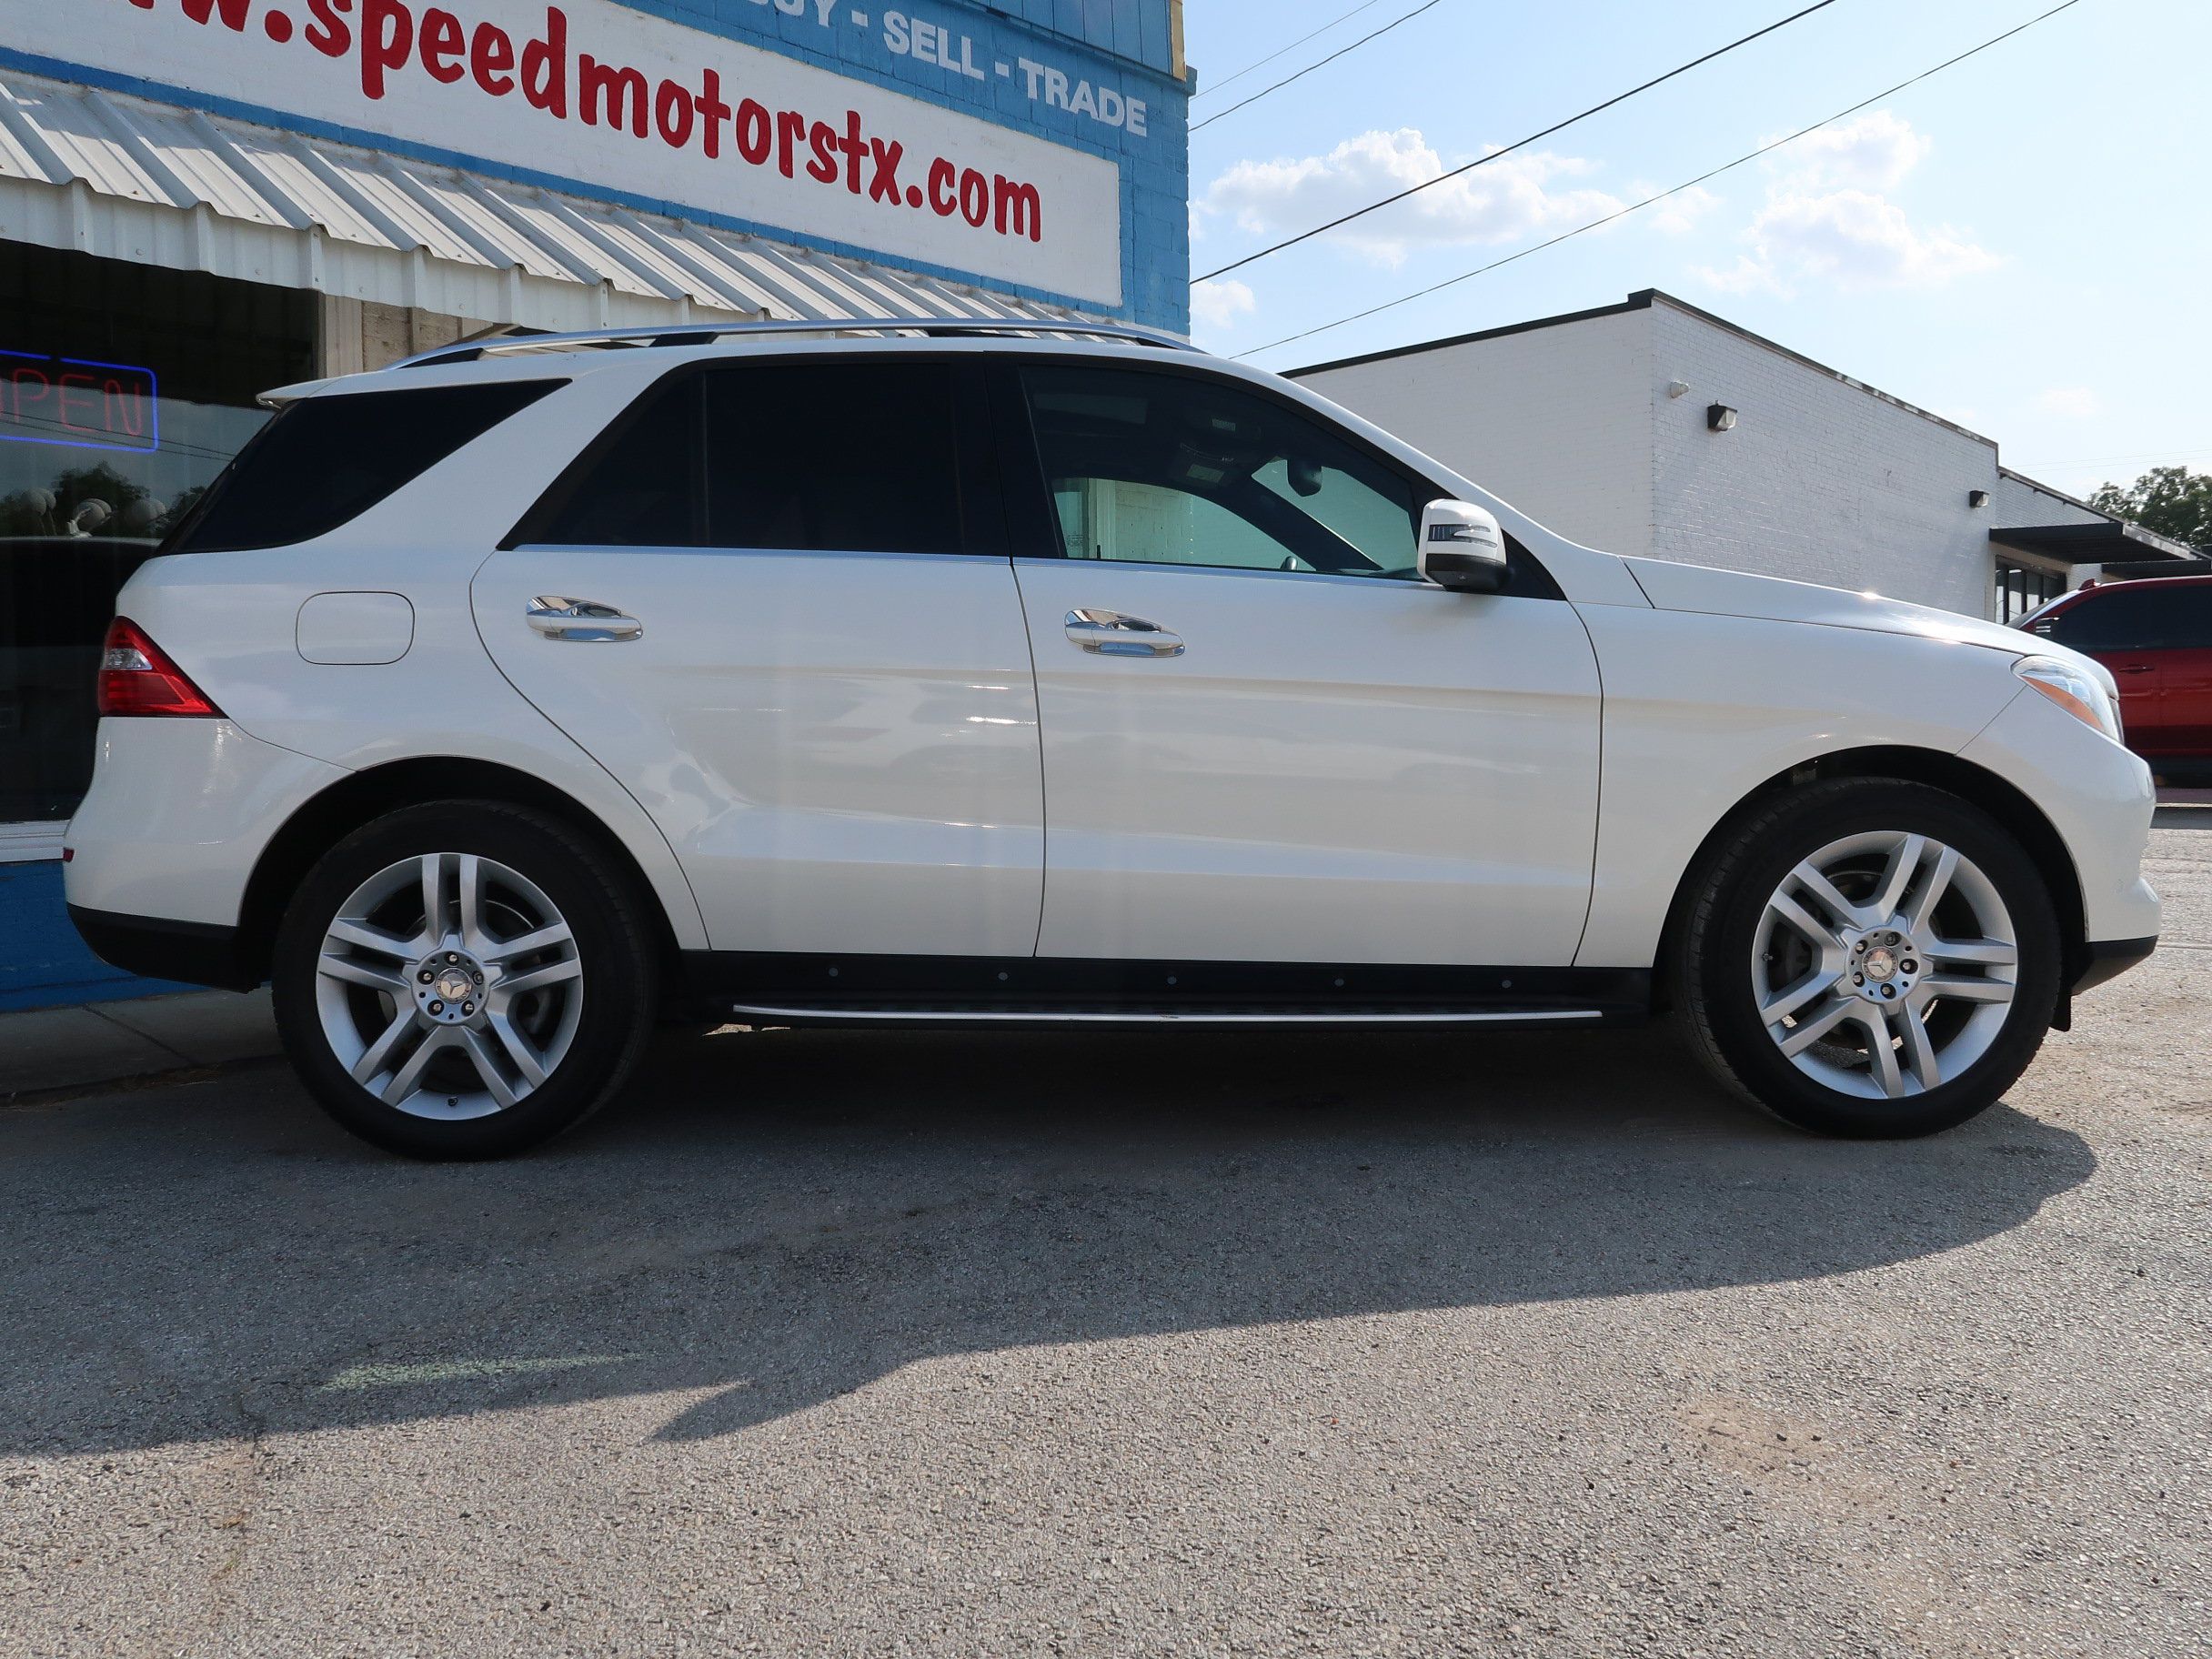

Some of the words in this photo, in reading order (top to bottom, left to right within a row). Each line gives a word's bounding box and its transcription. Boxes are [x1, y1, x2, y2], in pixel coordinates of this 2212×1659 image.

[130, 0, 1041, 242] .speedmotorstx.com
[883, 10, 985, 81] SELL
[1018, 56, 1147, 137] TRADE
[0, 367, 143, 437] PEN
